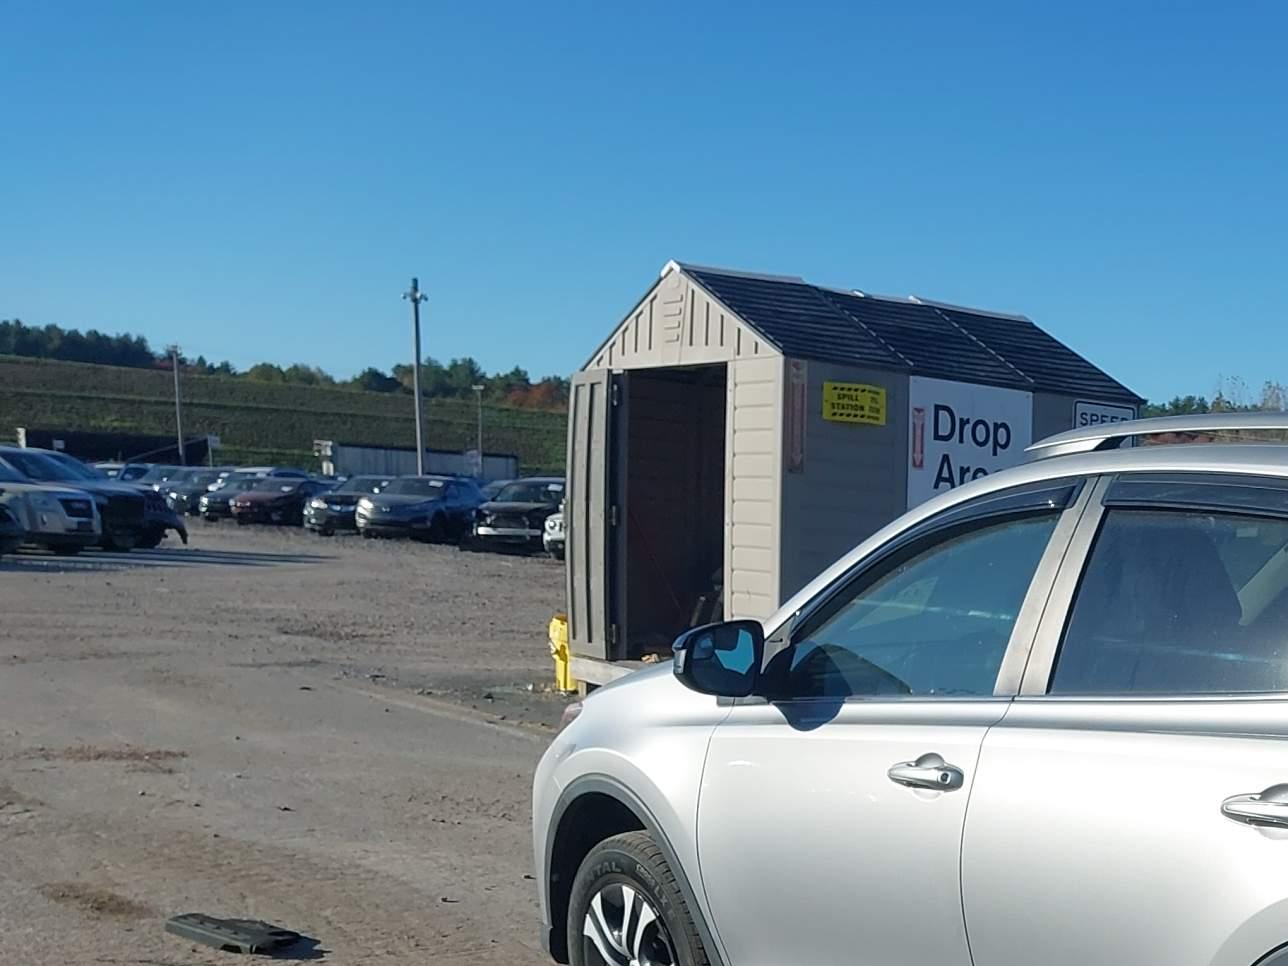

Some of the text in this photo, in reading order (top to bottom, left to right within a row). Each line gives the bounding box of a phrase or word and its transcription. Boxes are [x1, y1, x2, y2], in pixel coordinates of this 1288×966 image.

[831, 402, 865, 412] STATION
[1080, 412, 1129, 426] SPEE
[933, 403, 1011, 457] Drop
[933, 453, 1003, 490] Ar
